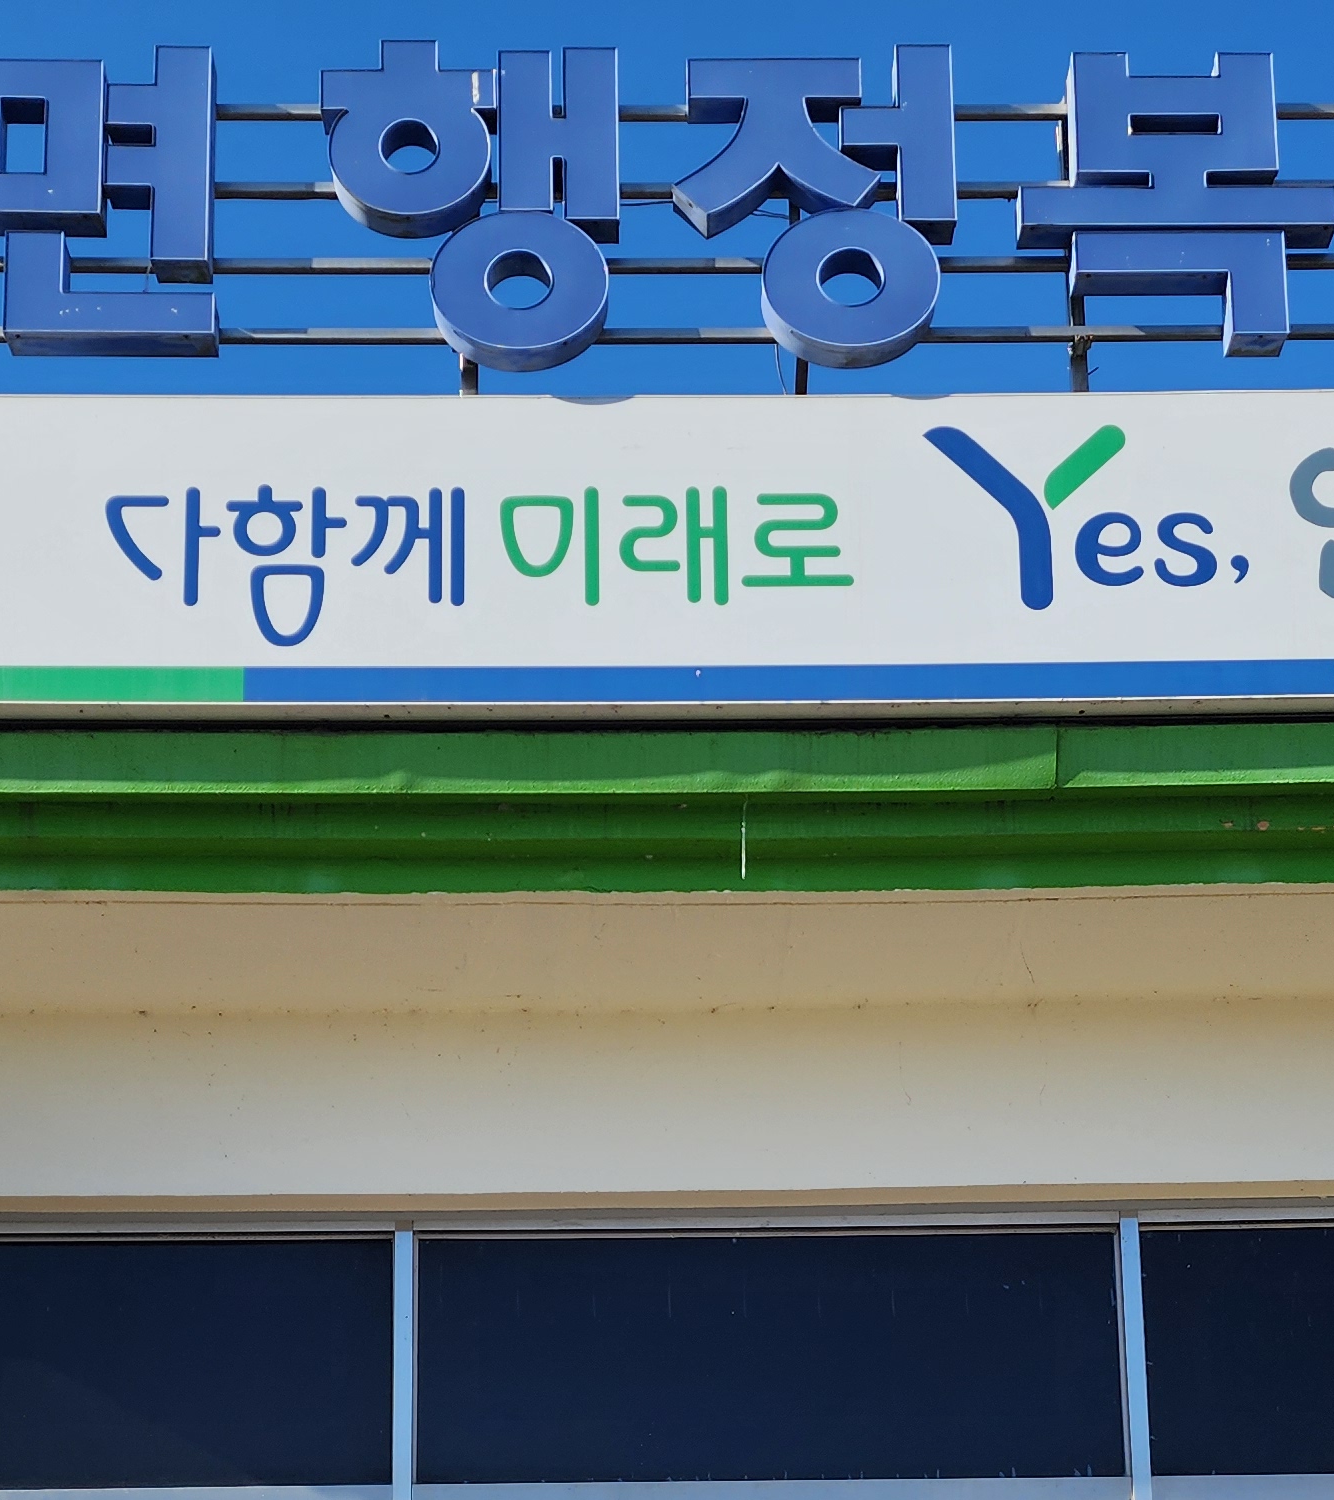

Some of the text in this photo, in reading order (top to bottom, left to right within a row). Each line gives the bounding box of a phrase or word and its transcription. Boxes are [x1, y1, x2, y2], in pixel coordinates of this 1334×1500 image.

[104, 484, 465, 650] 다함께
[498, 485, 854, 608] 미래로
[922, 424, 1250, 612] Yes,
